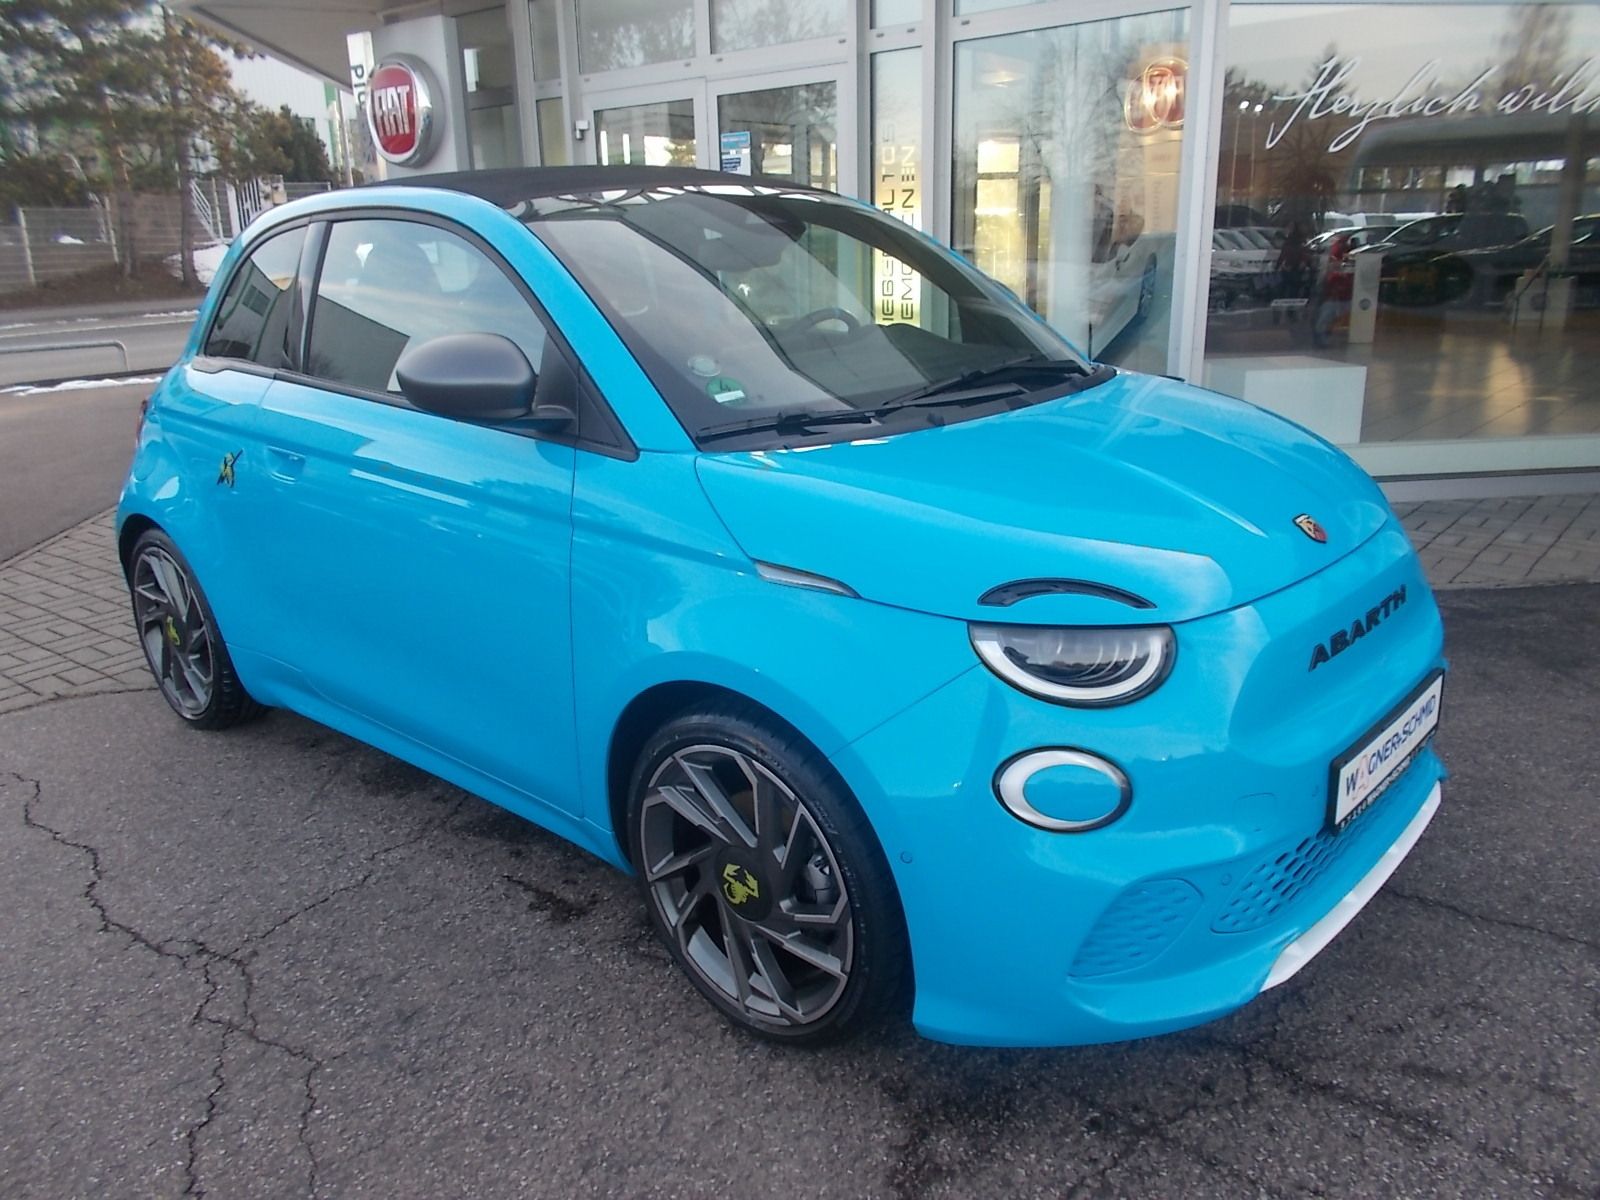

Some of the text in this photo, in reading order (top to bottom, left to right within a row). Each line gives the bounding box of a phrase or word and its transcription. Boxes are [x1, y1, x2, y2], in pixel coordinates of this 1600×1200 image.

[374, 84, 410, 137] FIAT
[1265, 56, 1498, 152] Herzlich
[1496, 55, 1600, 114] will
[1307, 584, 1407, 672] ABARTH
